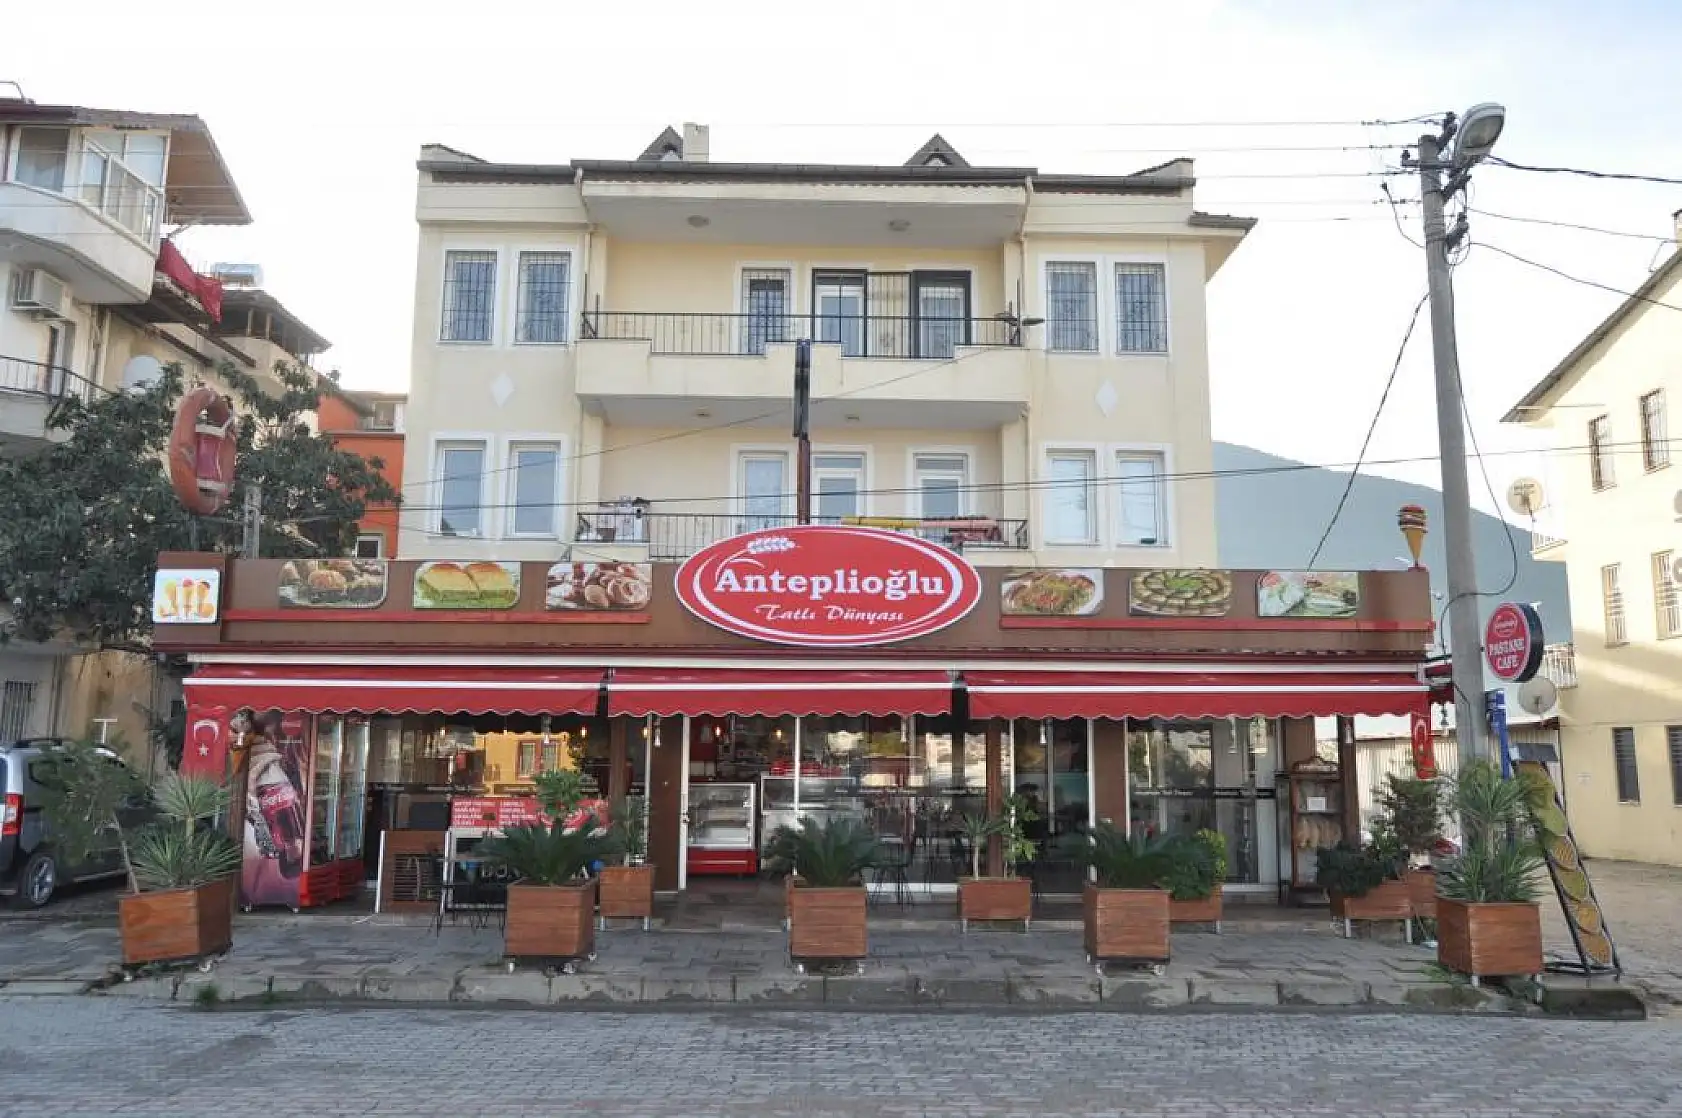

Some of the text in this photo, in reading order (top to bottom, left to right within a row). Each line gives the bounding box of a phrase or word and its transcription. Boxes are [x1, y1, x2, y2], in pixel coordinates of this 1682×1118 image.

[714, 568, 945, 600] Anteplioğlu
[755, 604, 904, 624] Tatlı Dünyası
[1497, 654, 1520, 669] CAFE
